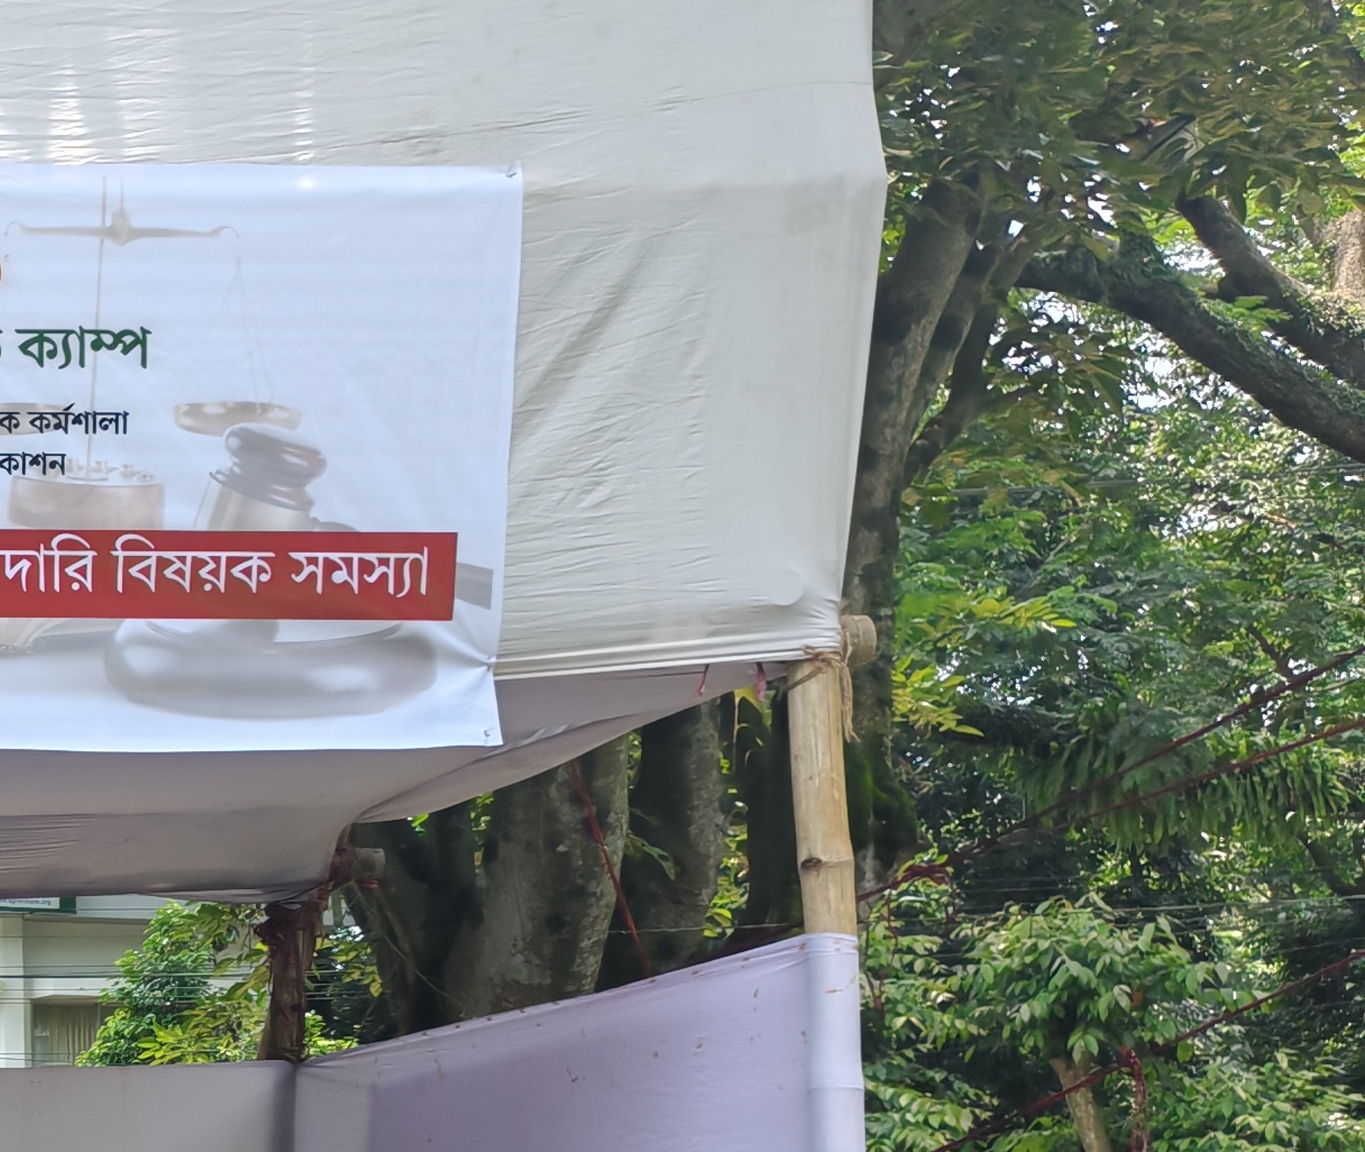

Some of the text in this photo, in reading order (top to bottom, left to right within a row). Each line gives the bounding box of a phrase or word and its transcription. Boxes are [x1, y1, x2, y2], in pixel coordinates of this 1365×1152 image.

[14, 325, 152, 370] ক্যাম্প
[26, 402, 130, 435] কর্মশালা
[109, 533, 276, 593] বিষয়ক
[288, 546, 428, 598] সমস্যা
